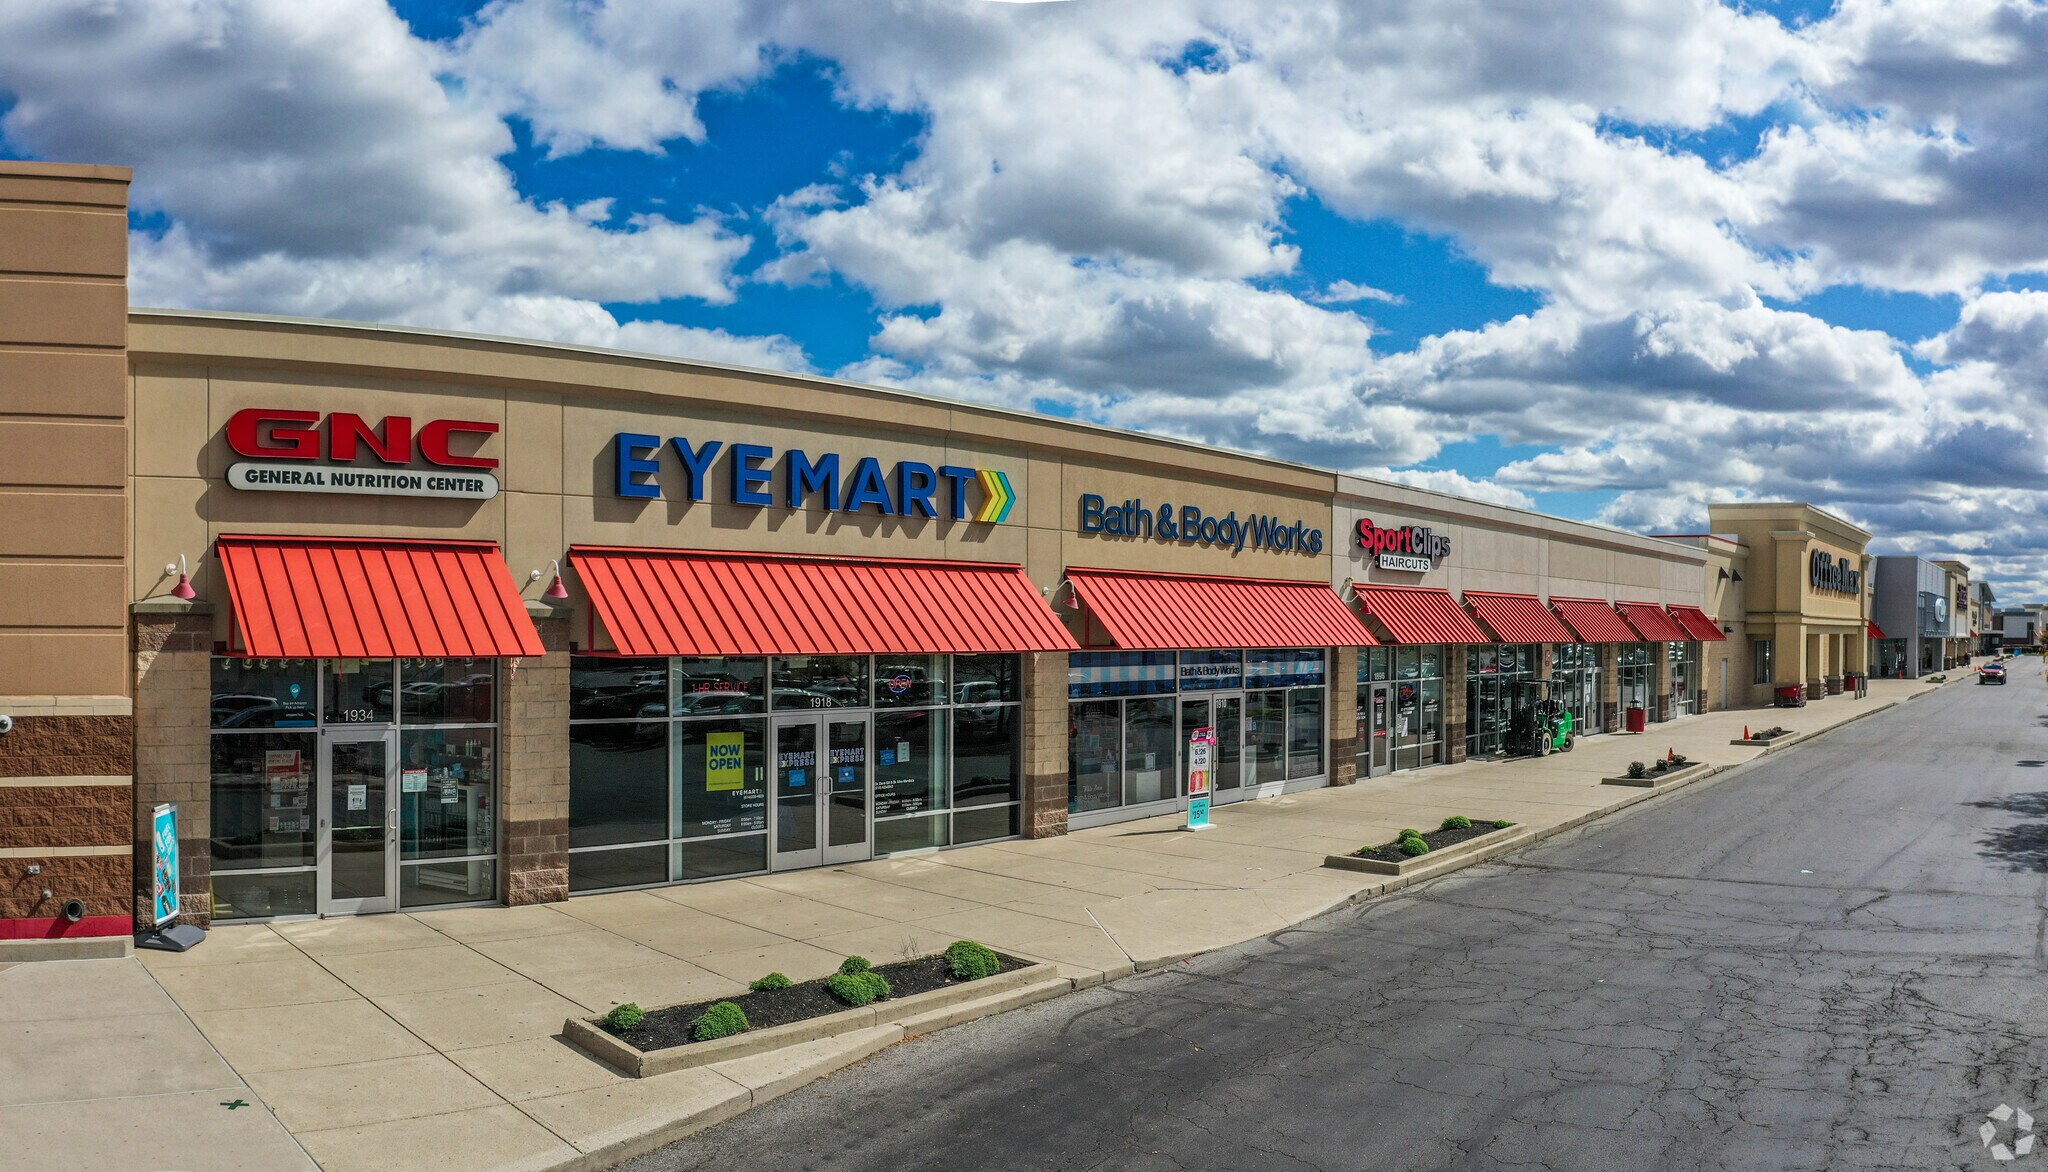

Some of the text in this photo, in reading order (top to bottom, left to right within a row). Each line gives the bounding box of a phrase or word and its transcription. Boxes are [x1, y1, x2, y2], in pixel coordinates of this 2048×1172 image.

[225, 407, 499, 469] GNC
[245, 469, 484, 493] GENERAL NUTRITION CENTER
[615, 432, 976, 520] EYEMART
[1081, 492, 1323, 554] Bath & Body Works
[1381, 555, 1430, 571] HAIRCUTS
[1181, 666, 1197, 677] Bath
[1203, 665, 1220, 677] Body
[1220, 664, 1240, 675] Works
[810, 697, 832, 708] 1918
[343, 709, 374, 722] 1934
[710, 744, 741, 757] NOW
[709, 757, 742, 770] OPEN
[731, 788, 760, 797] EYEMART
